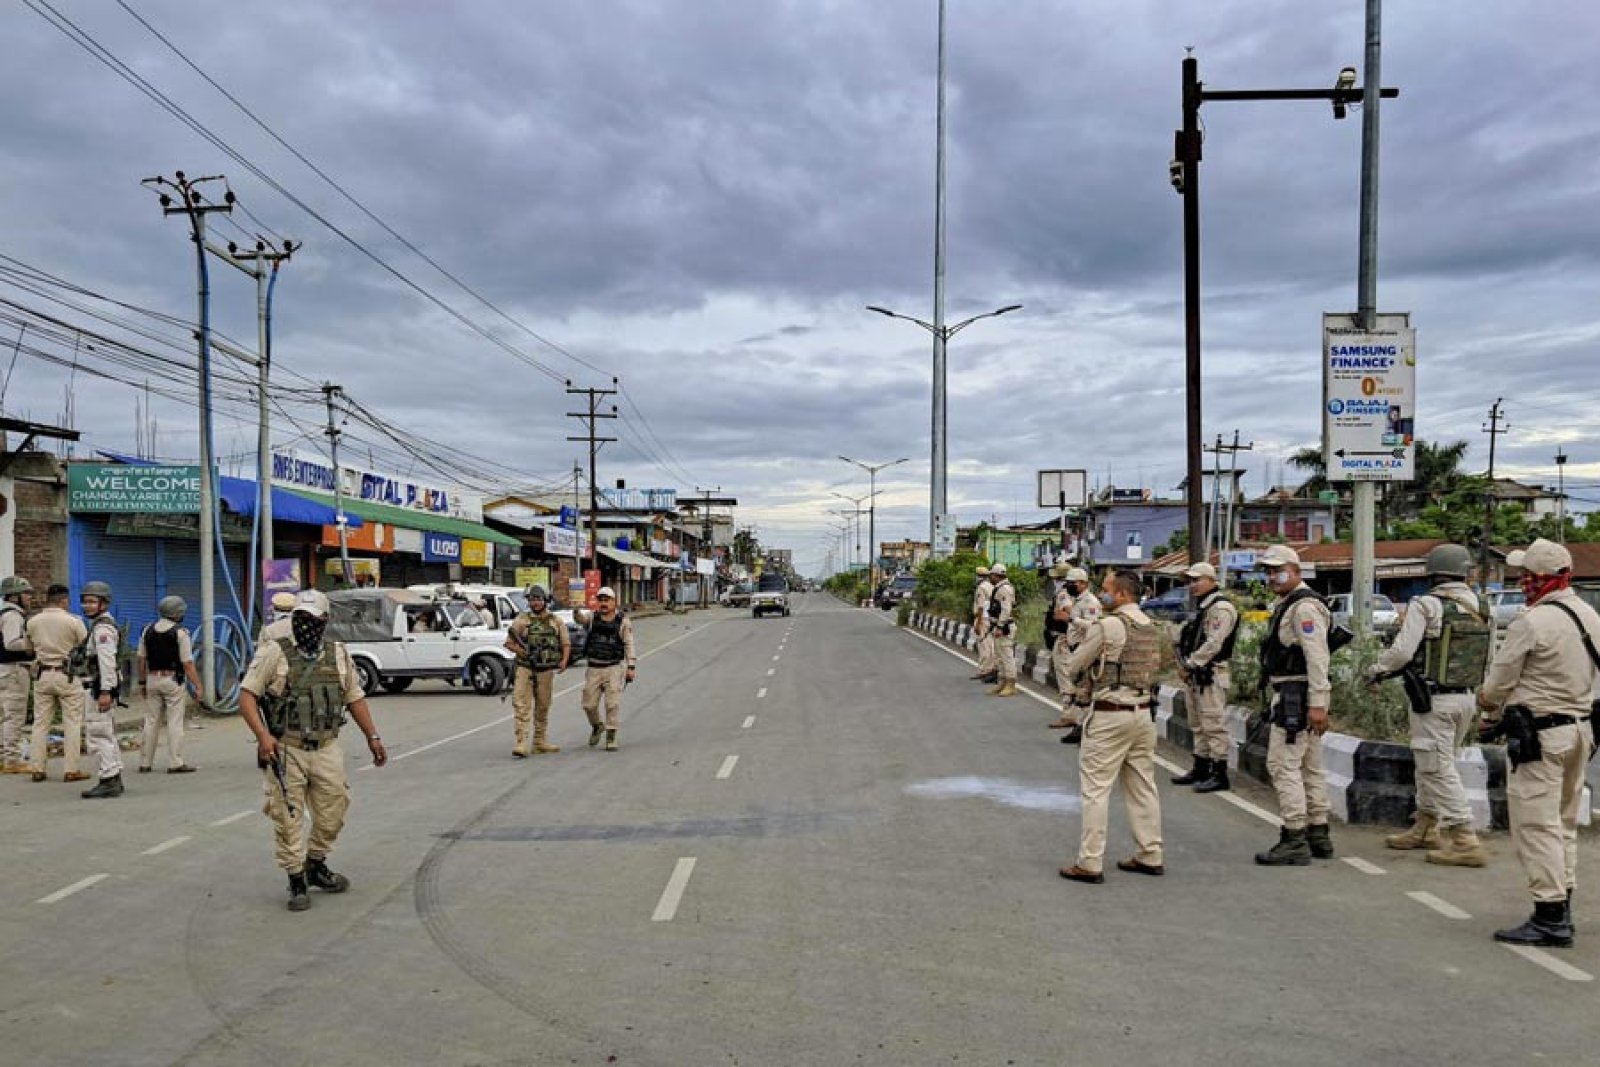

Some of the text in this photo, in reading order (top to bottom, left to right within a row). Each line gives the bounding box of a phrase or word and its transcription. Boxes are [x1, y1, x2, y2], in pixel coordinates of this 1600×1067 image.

[1331, 346, 1396, 356] SAMSUNG
[1342, 460, 1402, 468] DIGITAL PLAZA
[86, 476, 200, 490] WELCOME
[72, 491, 128, 500] CHANDRA
[129, 491, 177, 501] VARIETY
